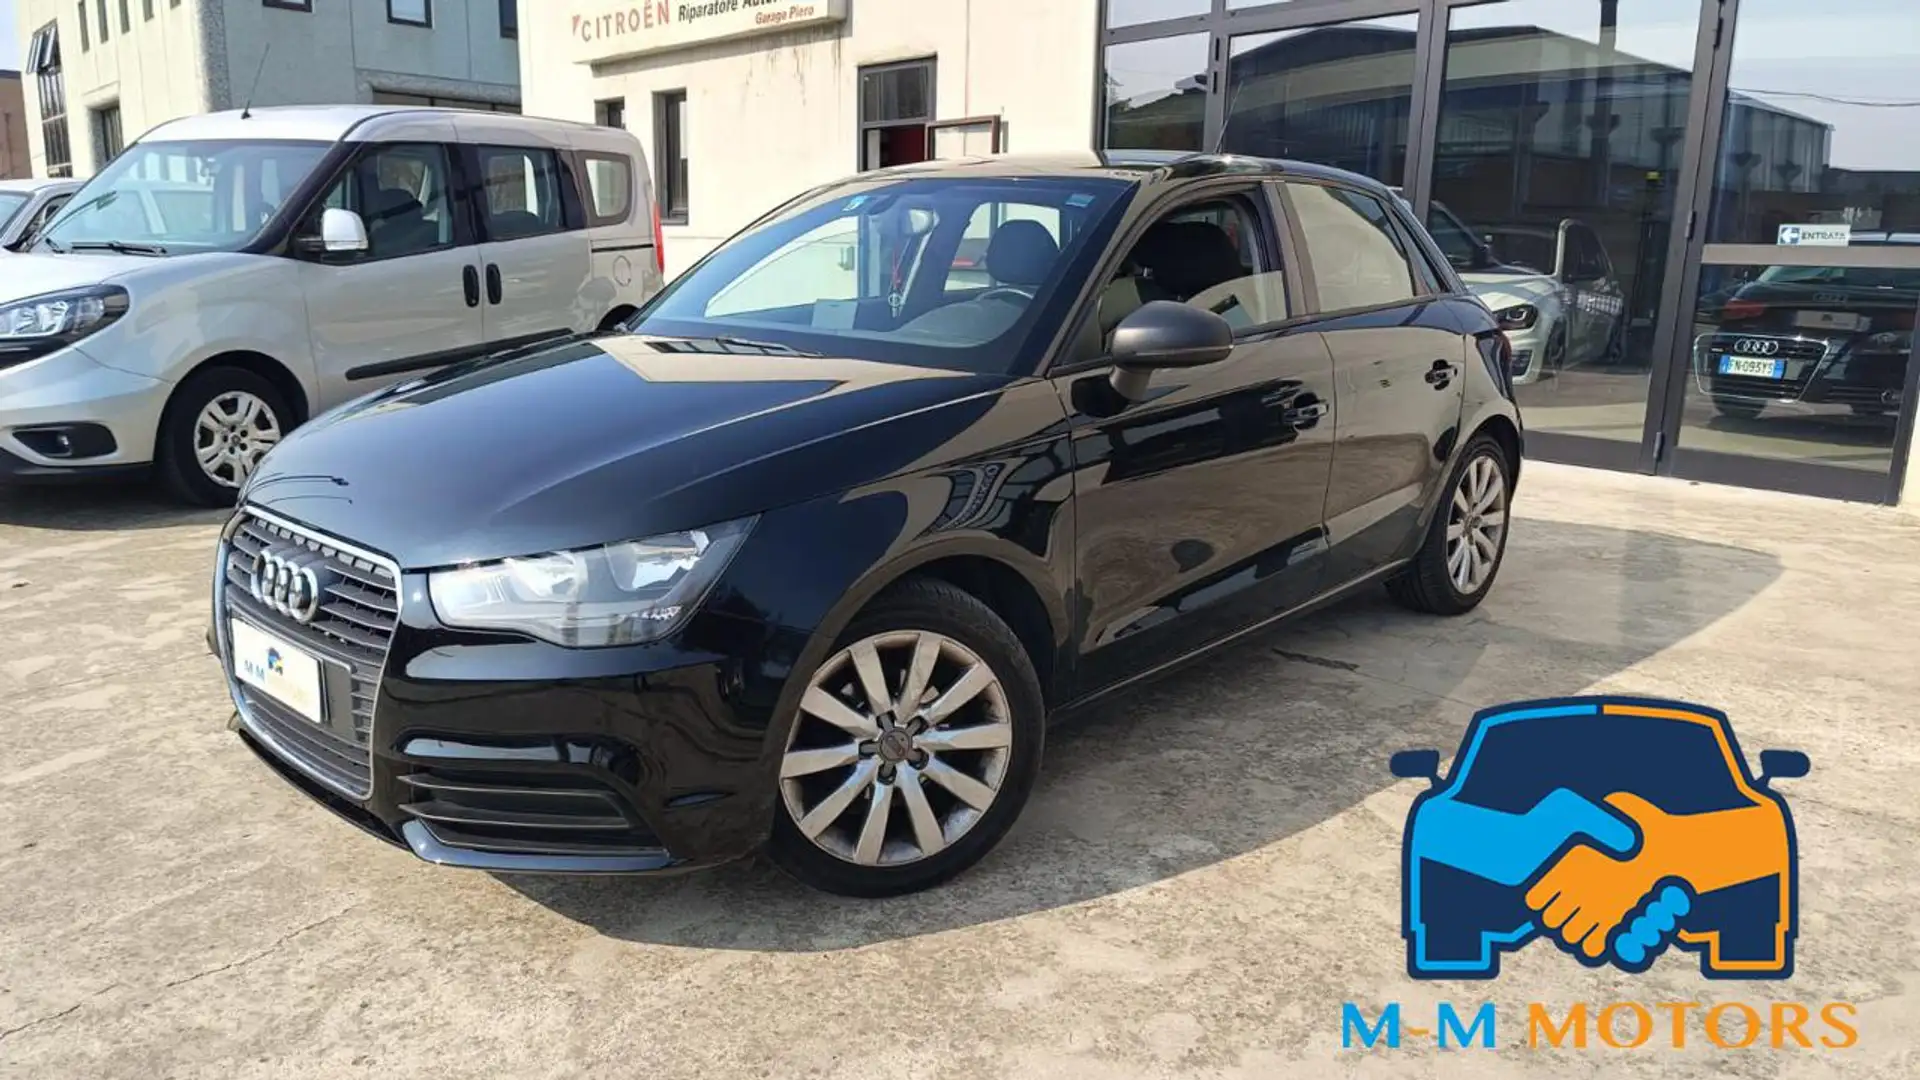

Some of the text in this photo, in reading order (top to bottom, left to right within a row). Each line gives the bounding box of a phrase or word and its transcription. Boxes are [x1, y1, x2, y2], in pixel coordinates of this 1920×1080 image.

[582, 0, 670, 42] CITROËN
[678, 1, 740, 24] Riparatore
[755, 5, 814, 25] Garage Piero
